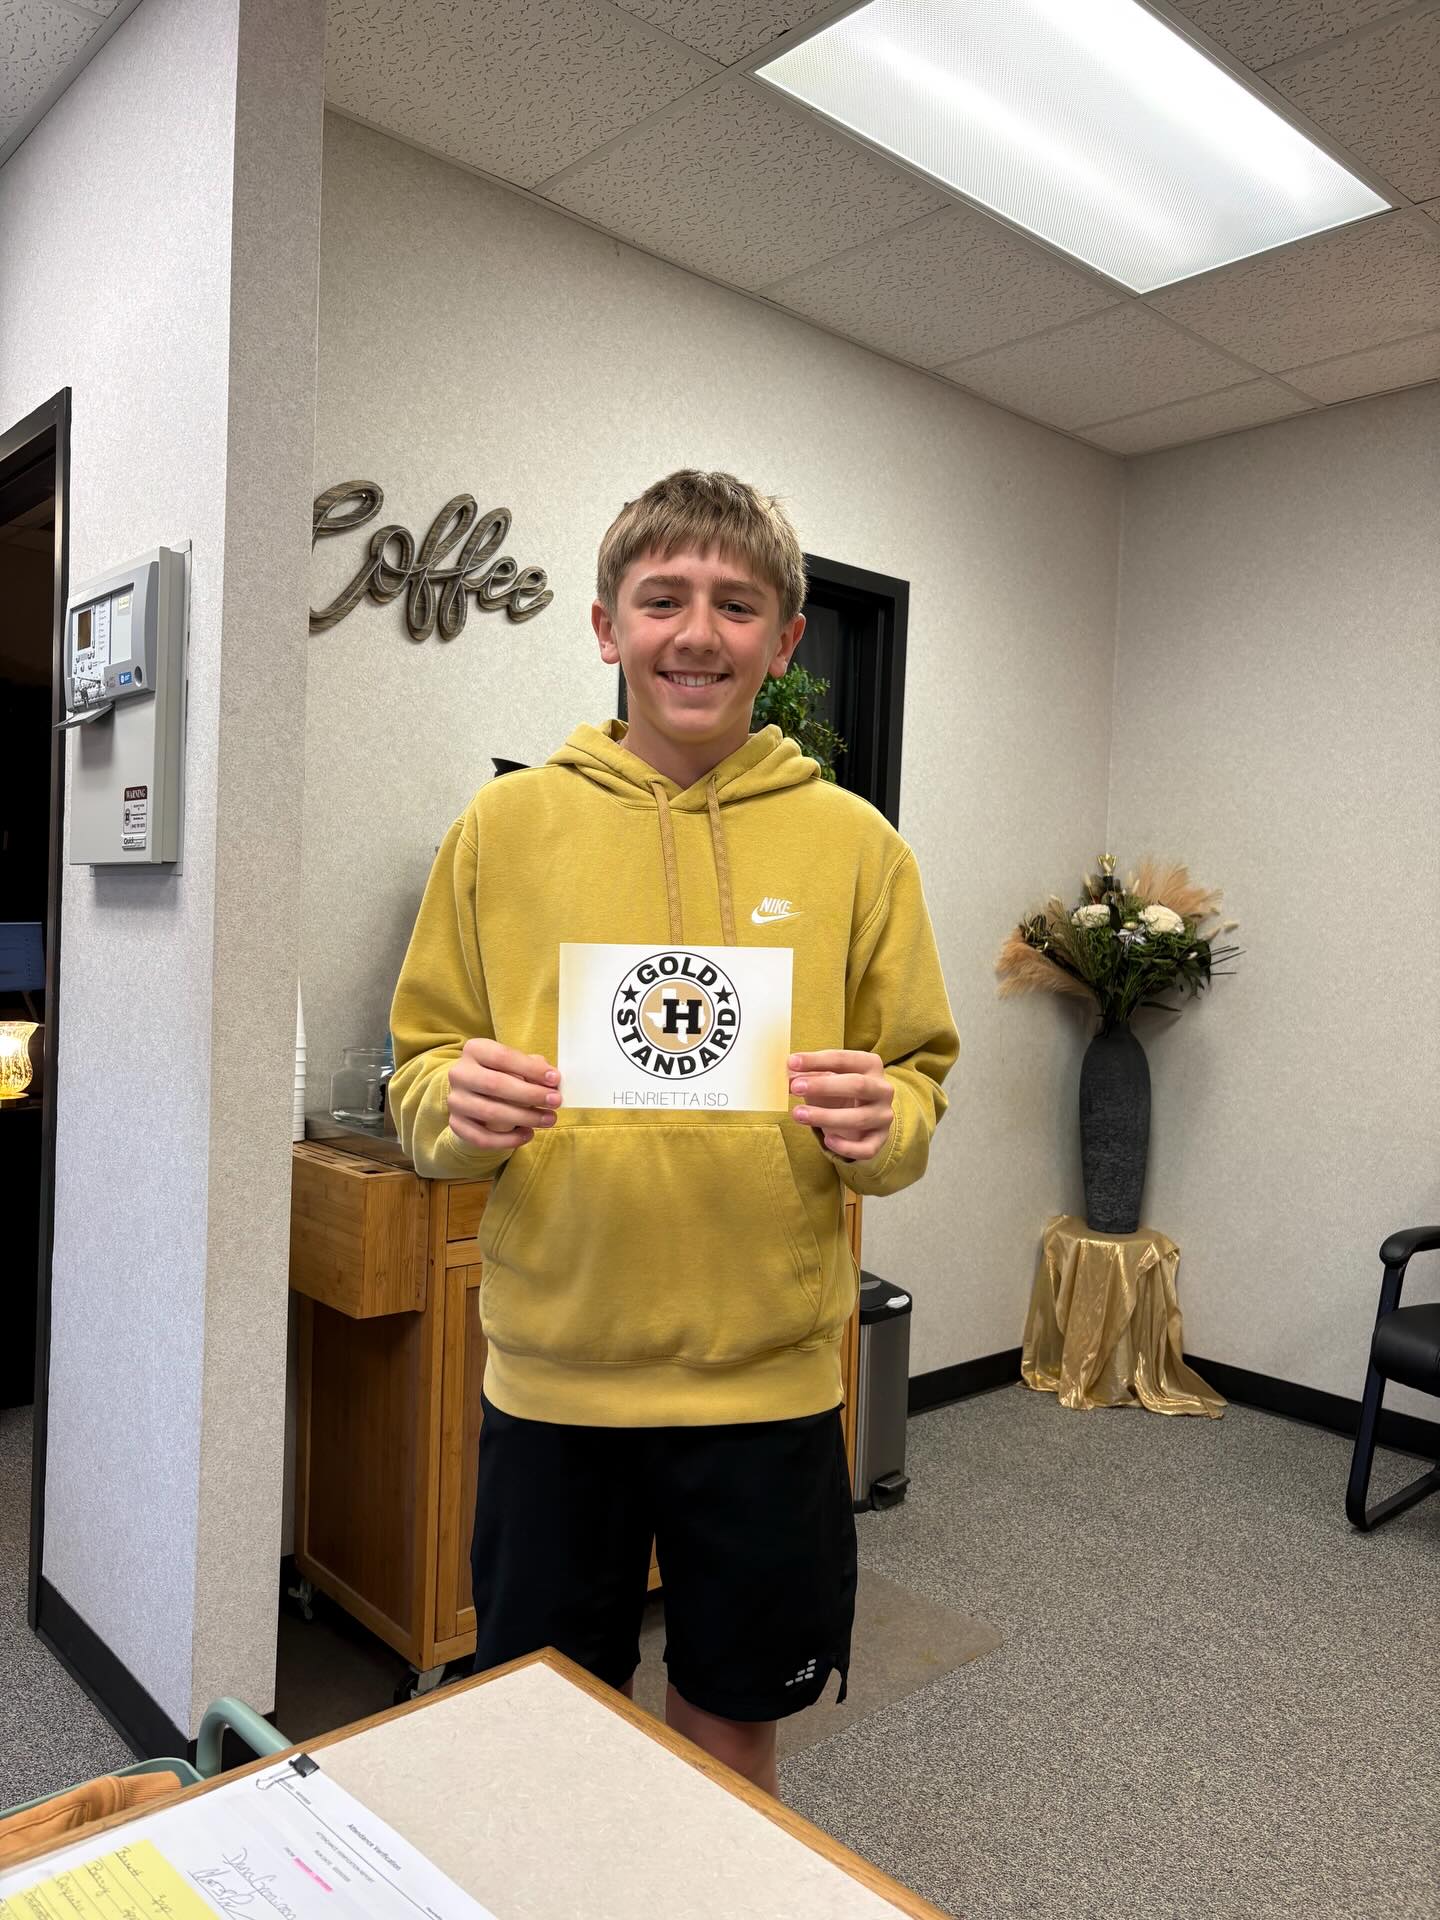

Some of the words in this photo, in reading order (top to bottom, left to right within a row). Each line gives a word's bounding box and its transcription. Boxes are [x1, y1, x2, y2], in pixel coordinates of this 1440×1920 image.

[308, 480, 554, 641] Coffee
[126, 788, 146, 799] WARNING
[760, 896, 792, 915] NIKE
[636, 956, 718, 987] GOLD
[662, 998, 703, 1035] H
[617, 1007, 736, 1076] STANDARD
[613, 1091, 701, 1106] HENRIETTA
[704, 1092, 729, 1107] ISD
